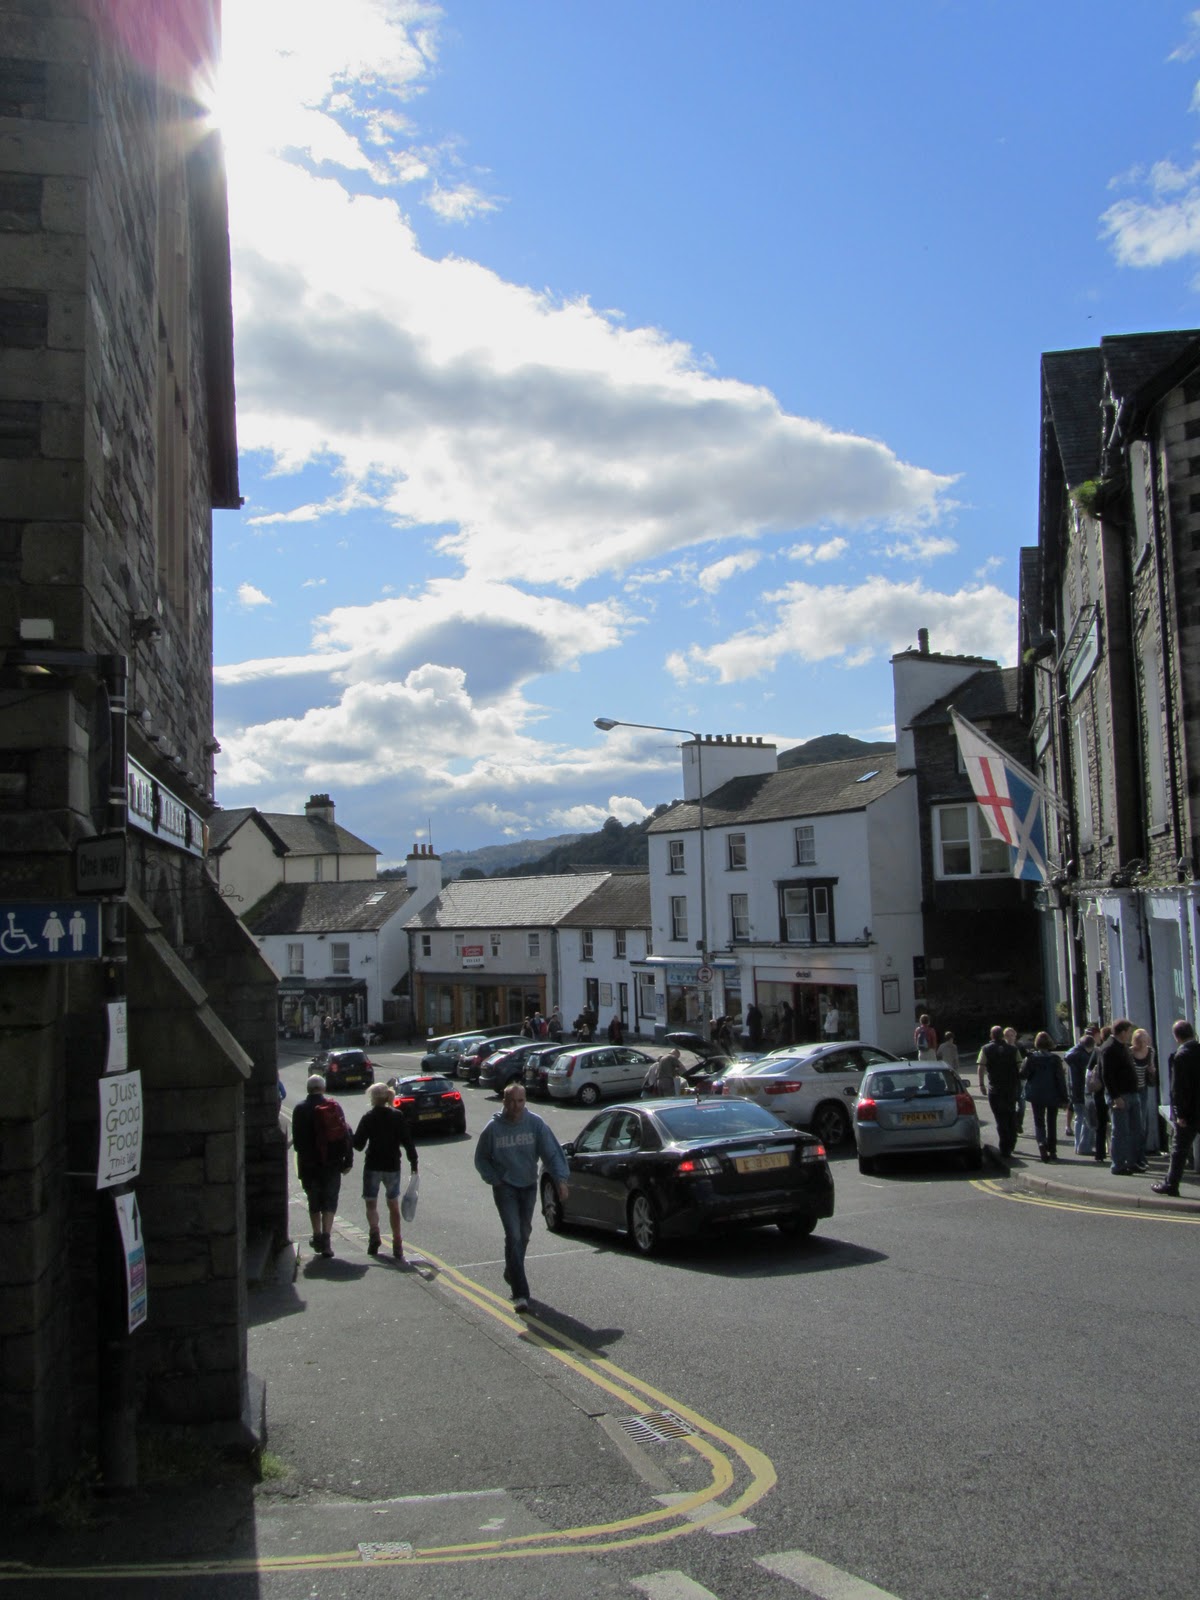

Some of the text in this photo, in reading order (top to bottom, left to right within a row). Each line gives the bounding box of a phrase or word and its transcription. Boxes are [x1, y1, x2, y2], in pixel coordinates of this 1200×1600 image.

[80, 854, 121, 879] One way
[109, 1083, 138, 1107] Just
[106, 1101, 140, 1133] Good
[107, 1127, 139, 1157] Food
